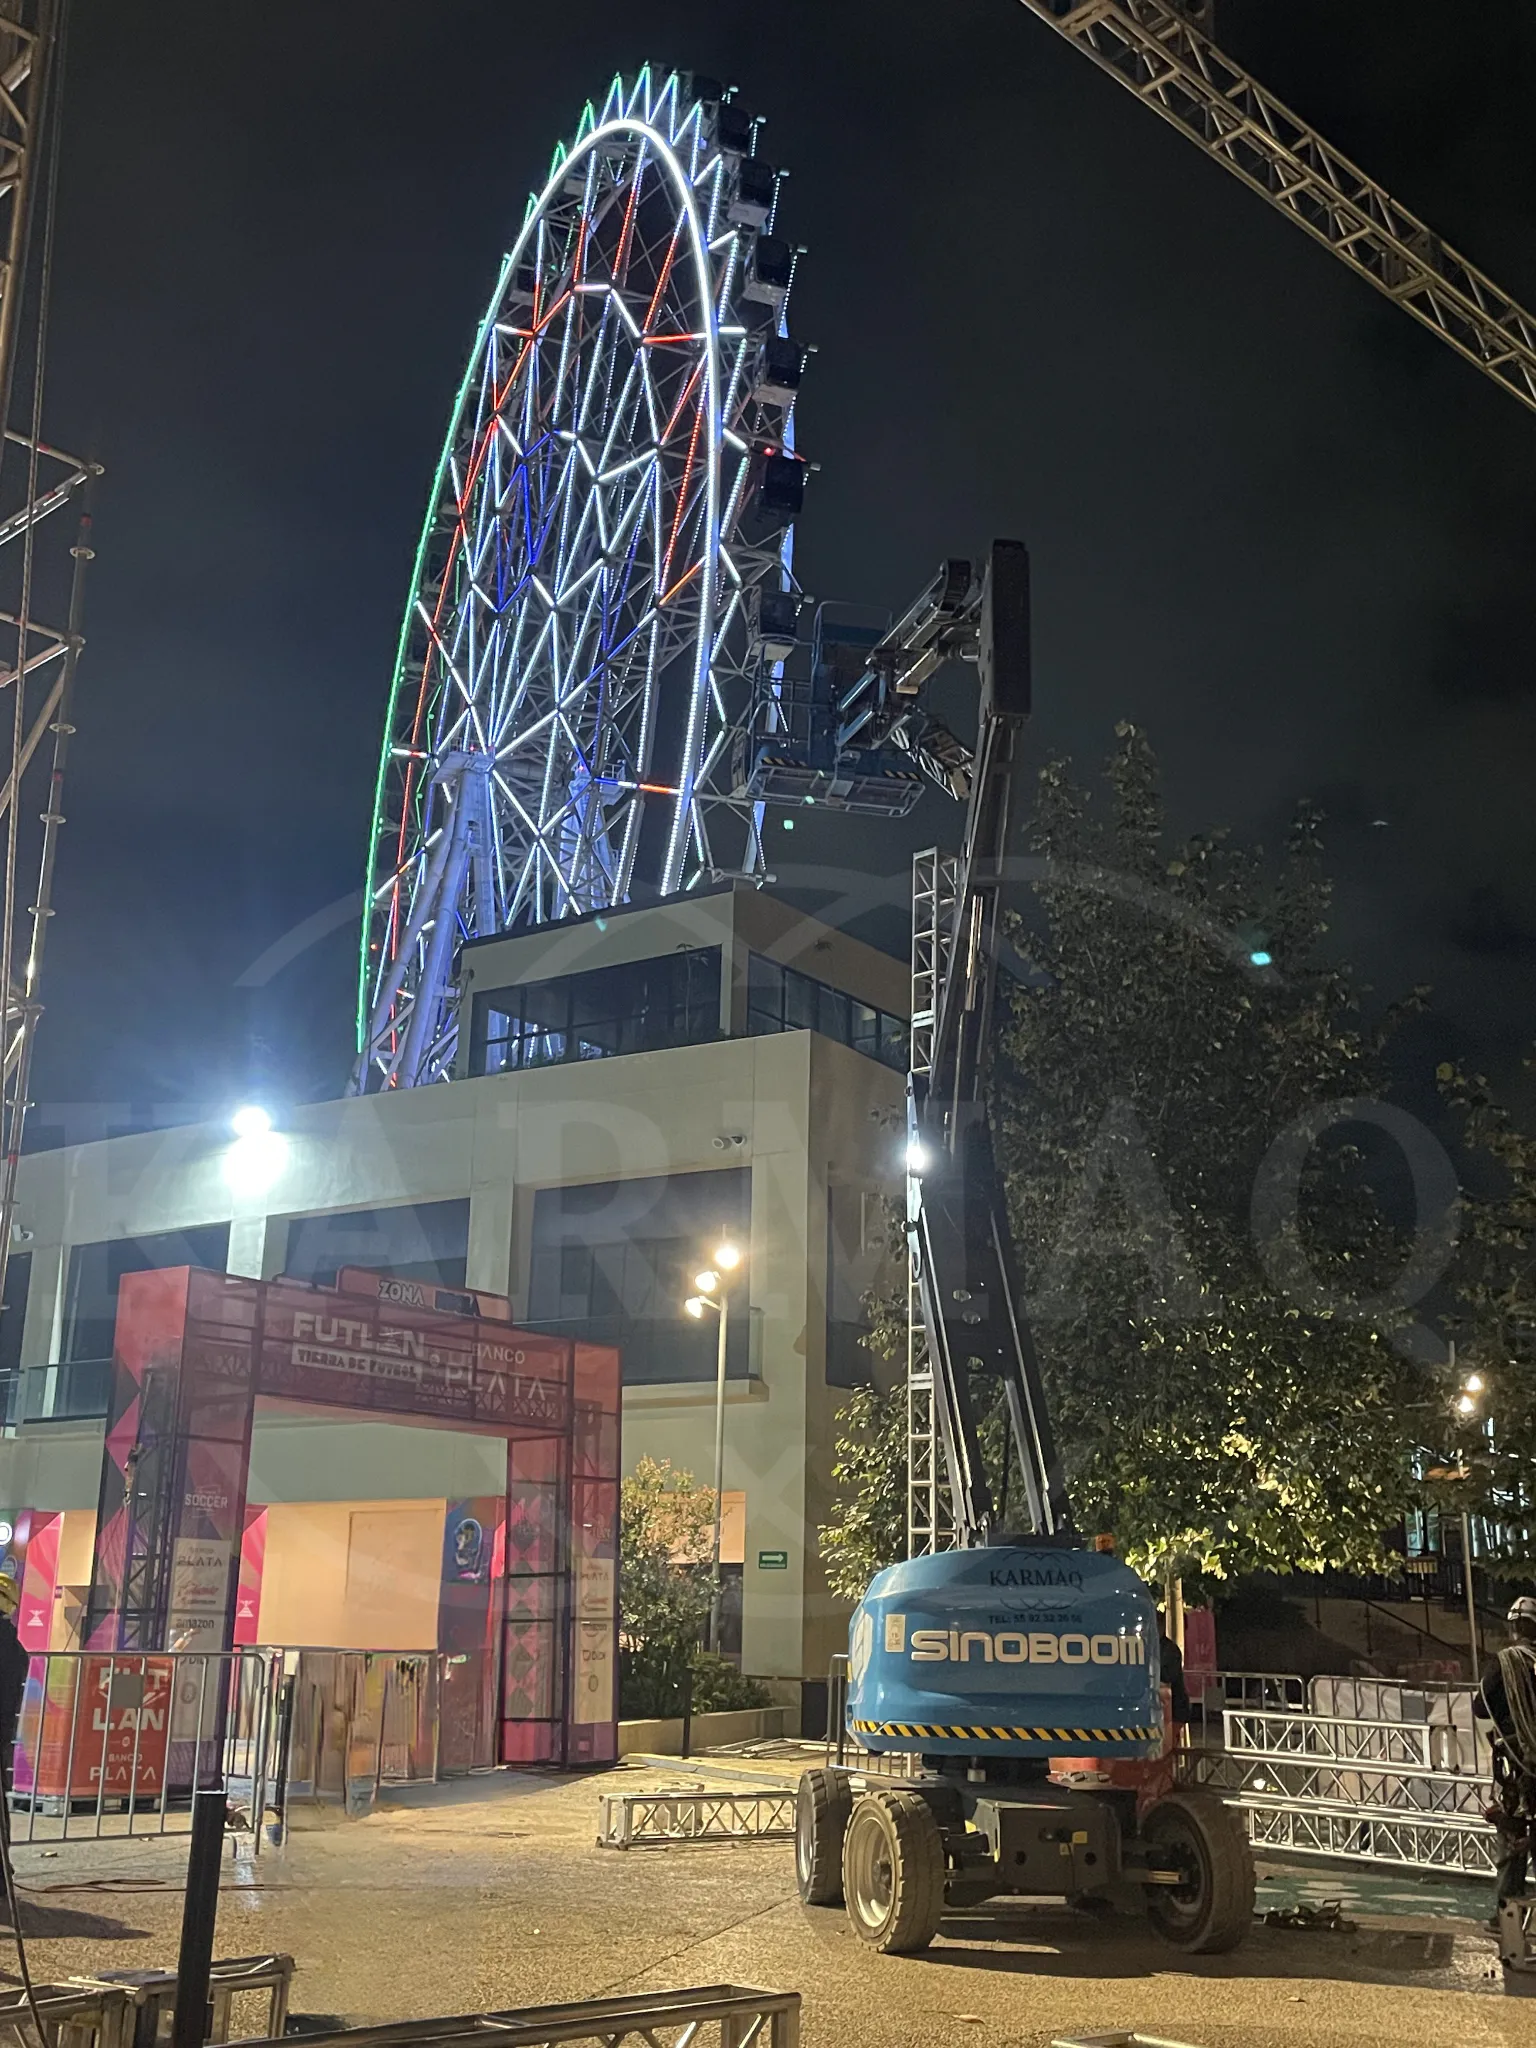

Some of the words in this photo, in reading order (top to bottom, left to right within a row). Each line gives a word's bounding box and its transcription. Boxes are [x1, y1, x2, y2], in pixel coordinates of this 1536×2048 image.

[379, 1280, 425, 1308] ZONA
[297, 1348, 345, 1369] TIERRA
[347, 1356, 367, 1371] DE
[445, 1364, 547, 1401] PLATA
[184, 1493, 229, 1509] SOCCER
[988, 1567, 1086, 1594] KARMAQ
[176, 1618, 215, 1629] amazon
[989, 1614, 1012, 1625] TEL:
[91, 1707, 165, 1731] LAN
[108, 1753, 143, 1763] BANCO
[89, 1766, 157, 1781] PLATA
